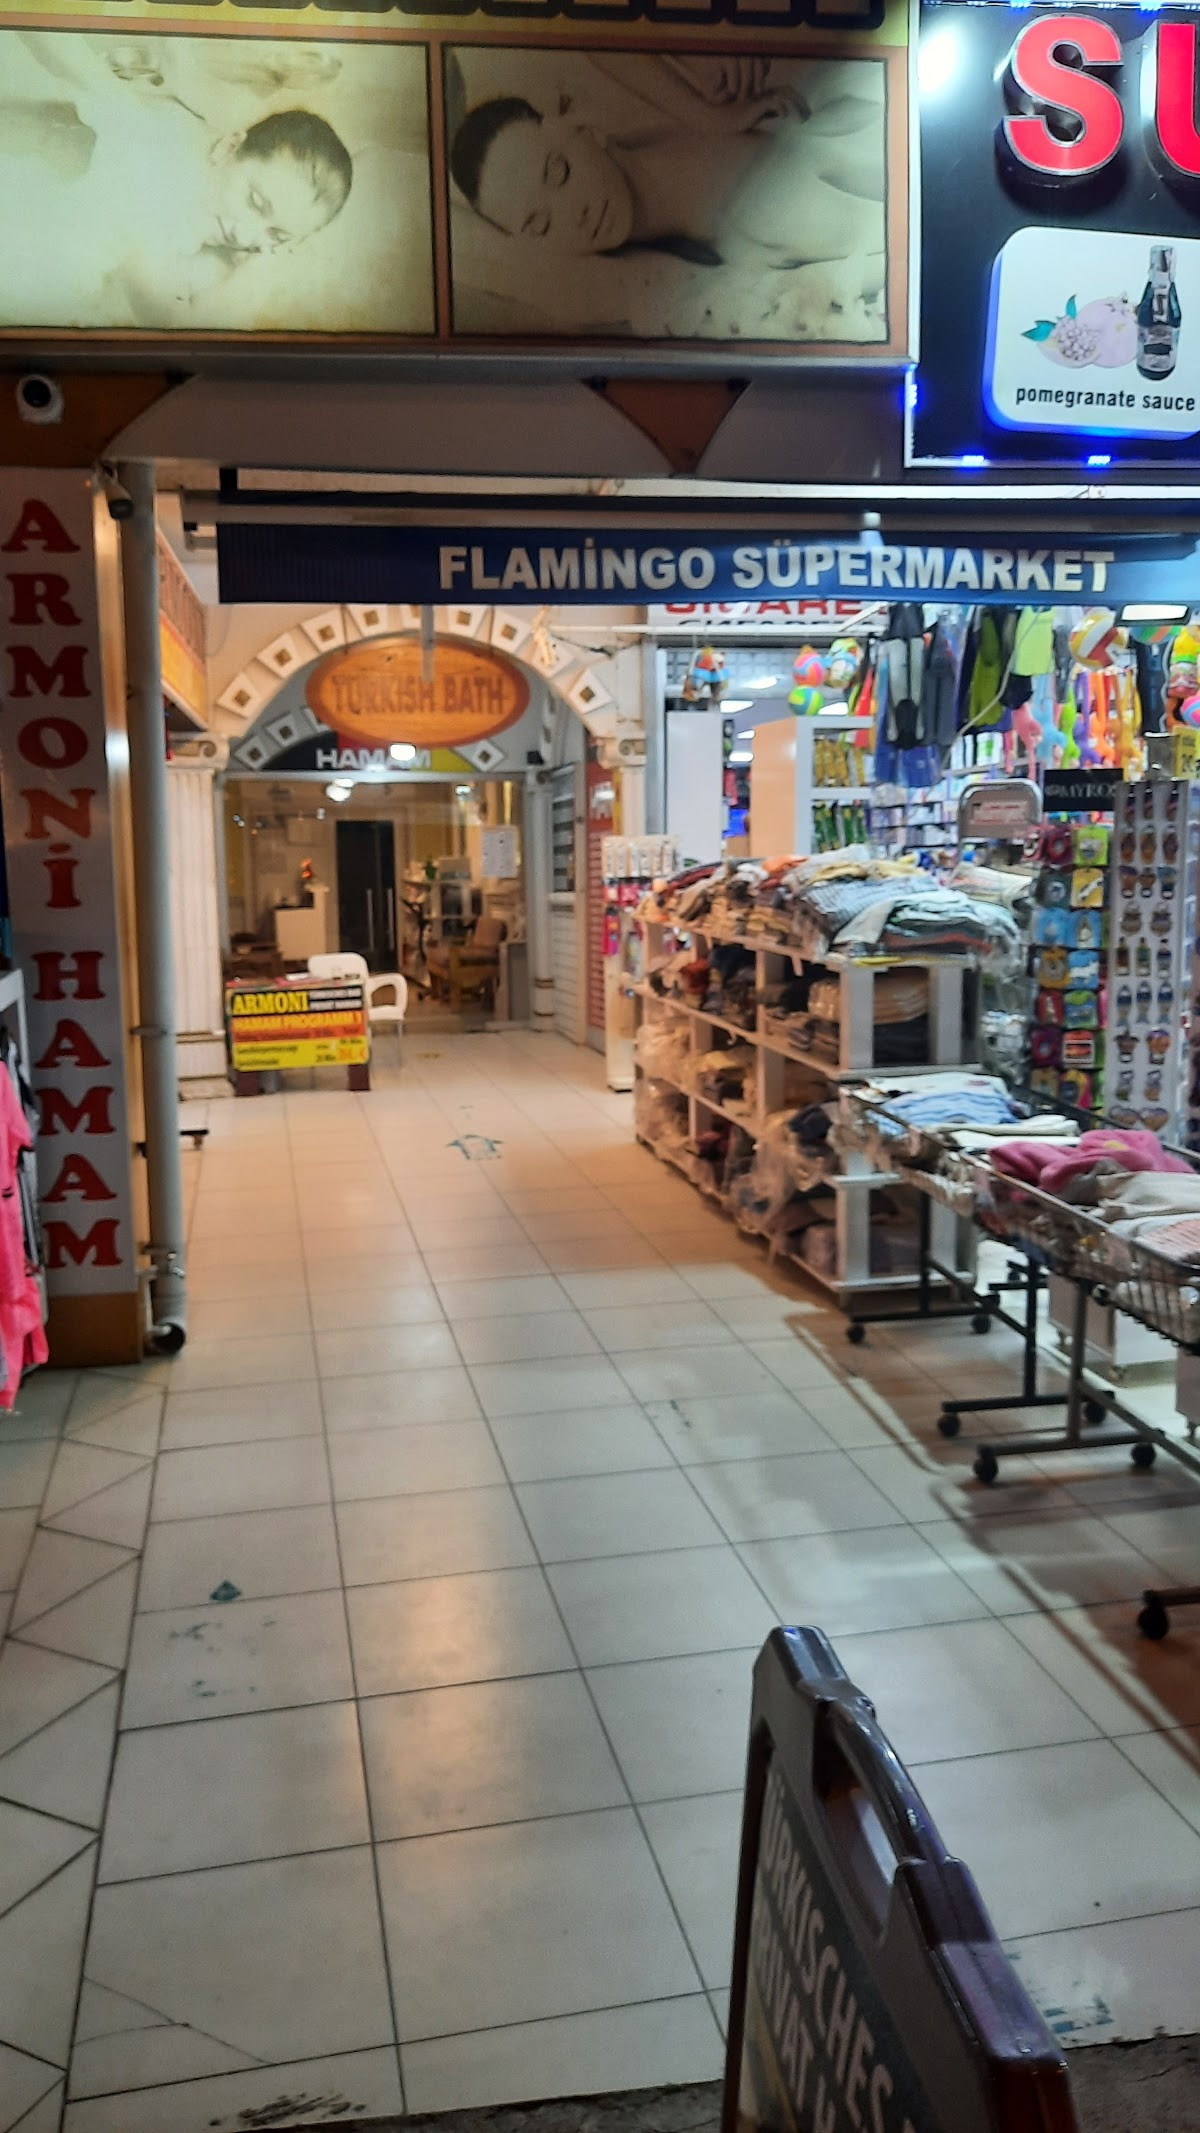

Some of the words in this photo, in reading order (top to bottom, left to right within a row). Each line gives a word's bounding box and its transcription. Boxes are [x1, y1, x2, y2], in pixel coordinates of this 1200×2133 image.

[1016, 385, 1136, 409] pomegranate
[1142, 392, 1196, 412] sauce
[438, 537, 716, 590] FLAMİNGO
[732, 537, 1115, 593] SÜPERMARKET
[333, 674, 436, 715] TURKISH
[443, 675, 504, 714] BATH
[31, 950, 124, 1269] HAMAM
